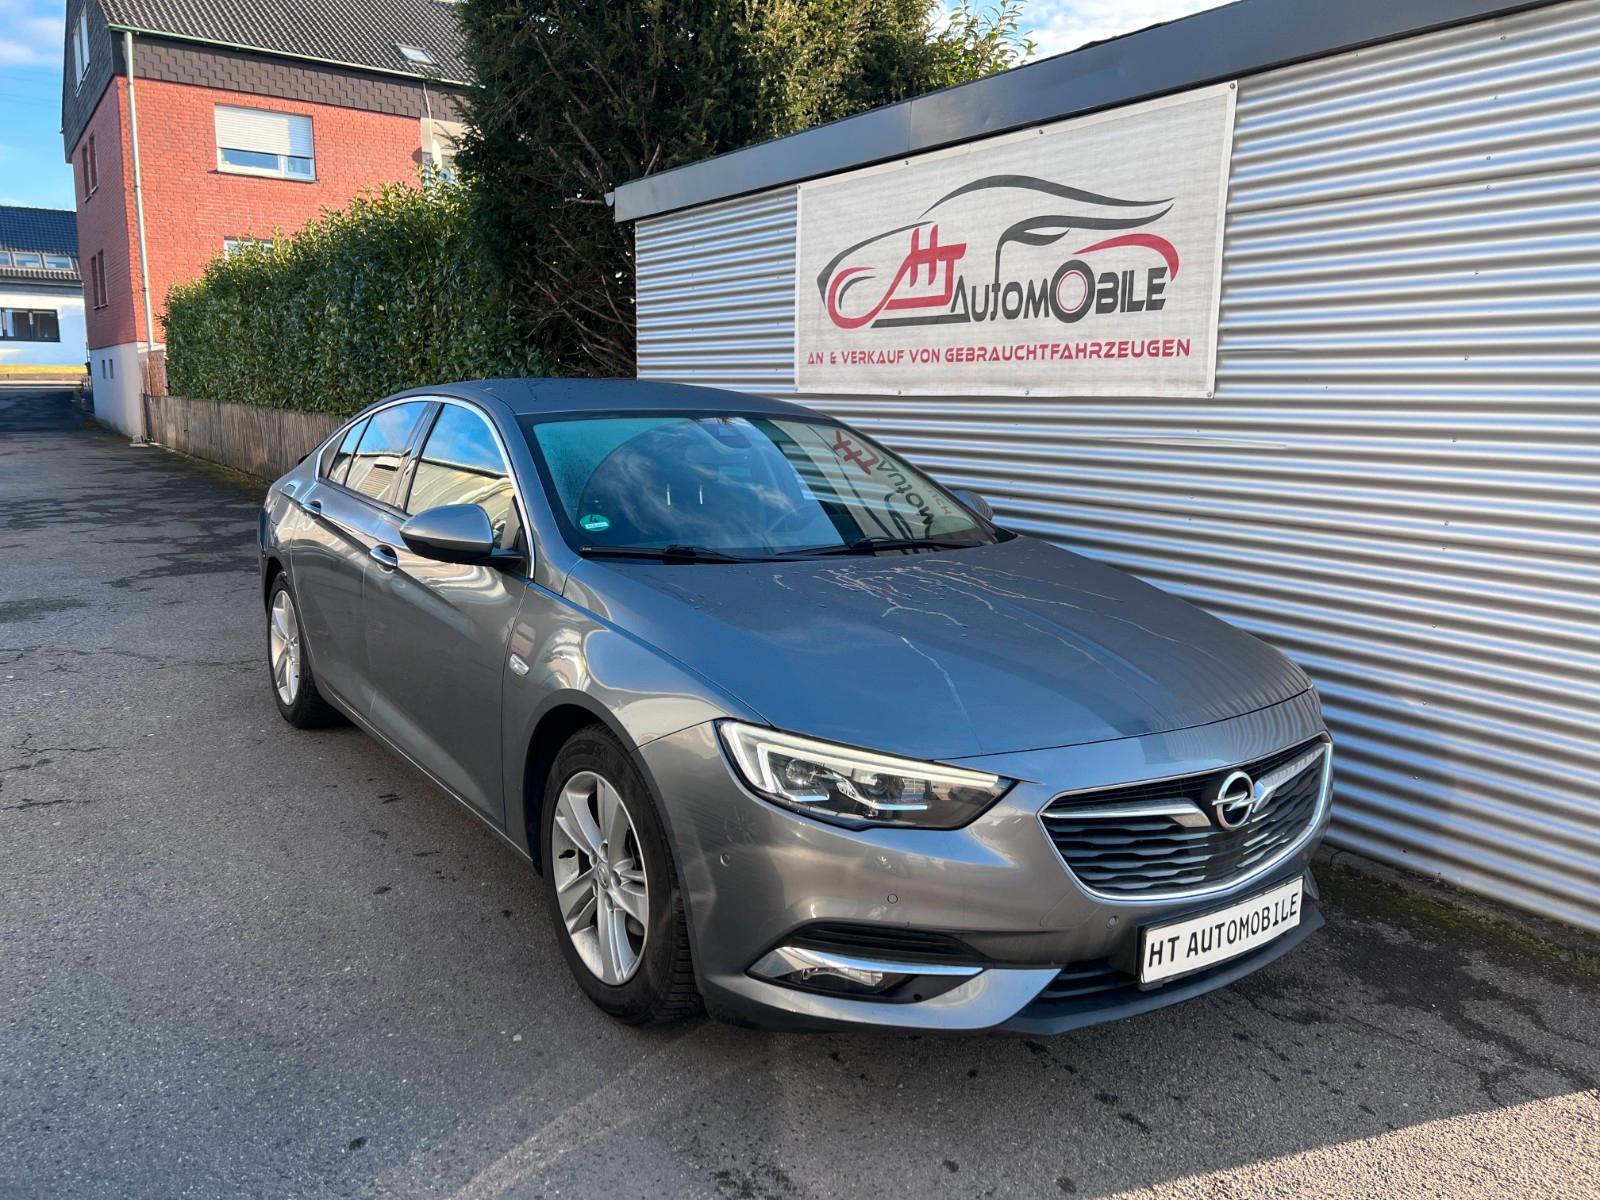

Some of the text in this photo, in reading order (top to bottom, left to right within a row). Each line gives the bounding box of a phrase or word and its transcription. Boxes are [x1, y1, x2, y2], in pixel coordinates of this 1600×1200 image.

[893, 224, 1168, 323] HT AUTOMOBILE
[807, 338, 1191, 365] AN & VERKAUF VON GEBRAUCHTFAHRZEUGEN
[1148, 891, 1299, 968] HT AUTOMOBILE
